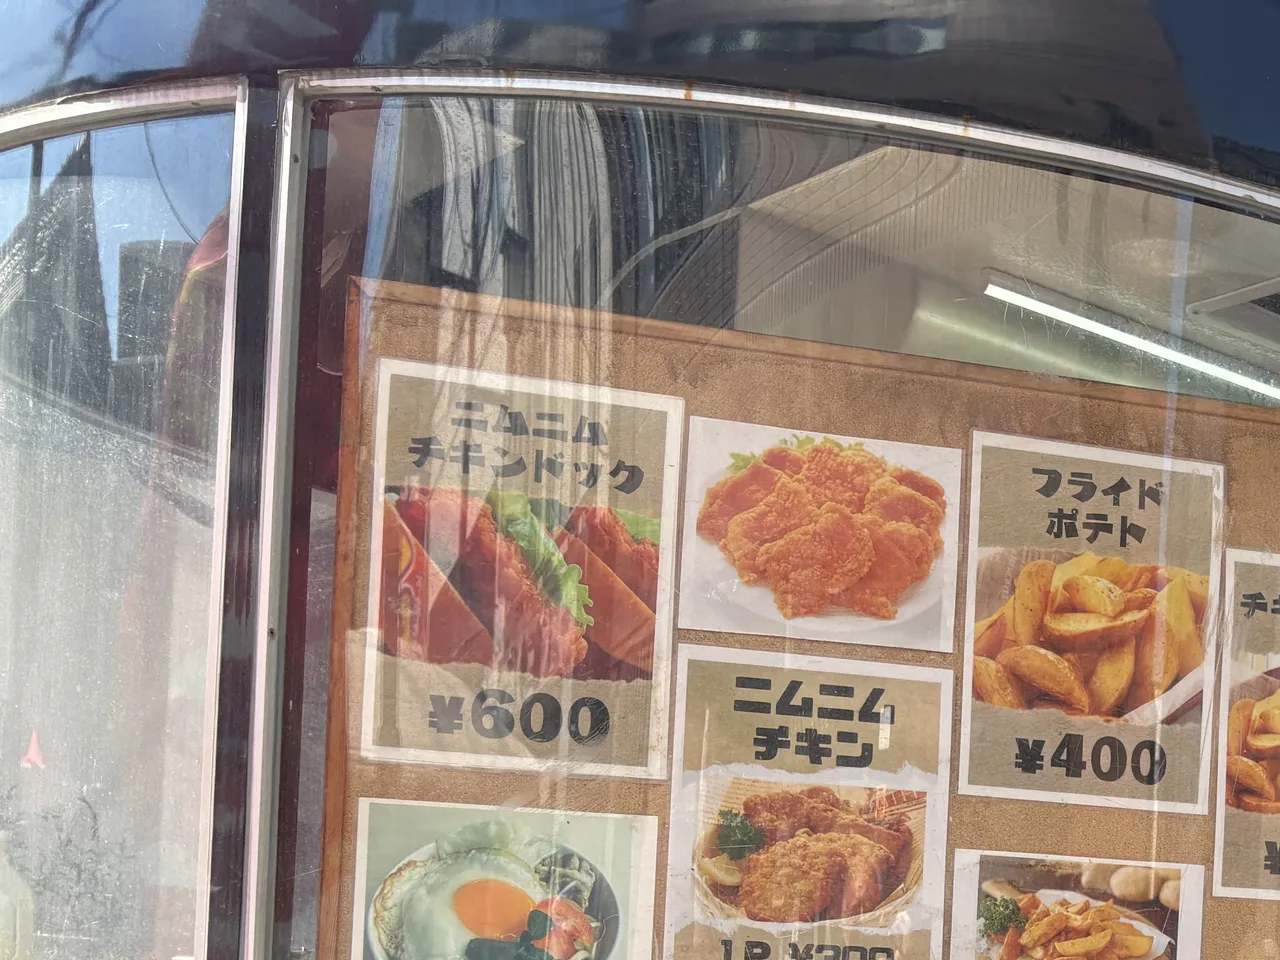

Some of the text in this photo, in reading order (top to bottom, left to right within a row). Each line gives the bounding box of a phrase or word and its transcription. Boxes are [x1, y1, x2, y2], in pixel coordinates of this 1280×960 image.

[451, 401, 609, 446] ニムニム
[408, 436, 645, 494] チキンドック
[1031, 467, 1164, 509] フライド
[1047, 508, 1147, 547] ポテト
[428, 688, 611, 746] ¥600
[733, 676, 896, 725] ニムニム
[753, 726, 874, 768] チキン
[1014, 733, 1168, 786] ¥400
